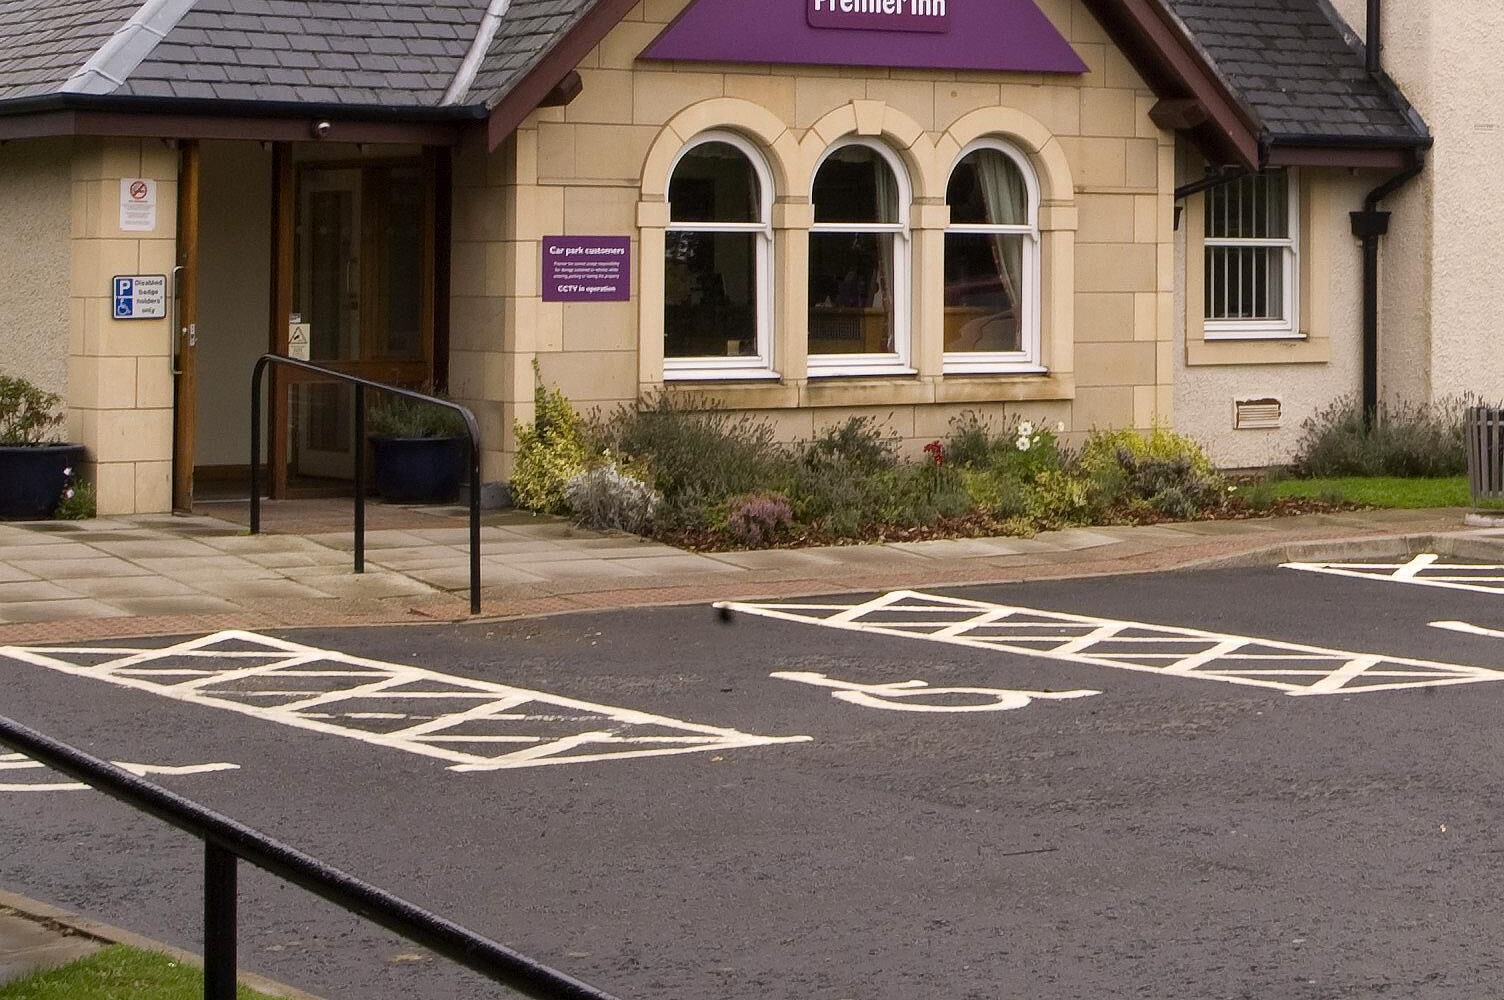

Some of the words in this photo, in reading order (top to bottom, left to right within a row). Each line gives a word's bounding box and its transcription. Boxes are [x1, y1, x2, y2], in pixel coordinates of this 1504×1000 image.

[549, 245, 565, 255] Car
[566, 246, 584, 257] park
[584, 247, 625, 255] customers
[119, 280, 131, 296] P
[557, 284, 578, 293] CCTV
